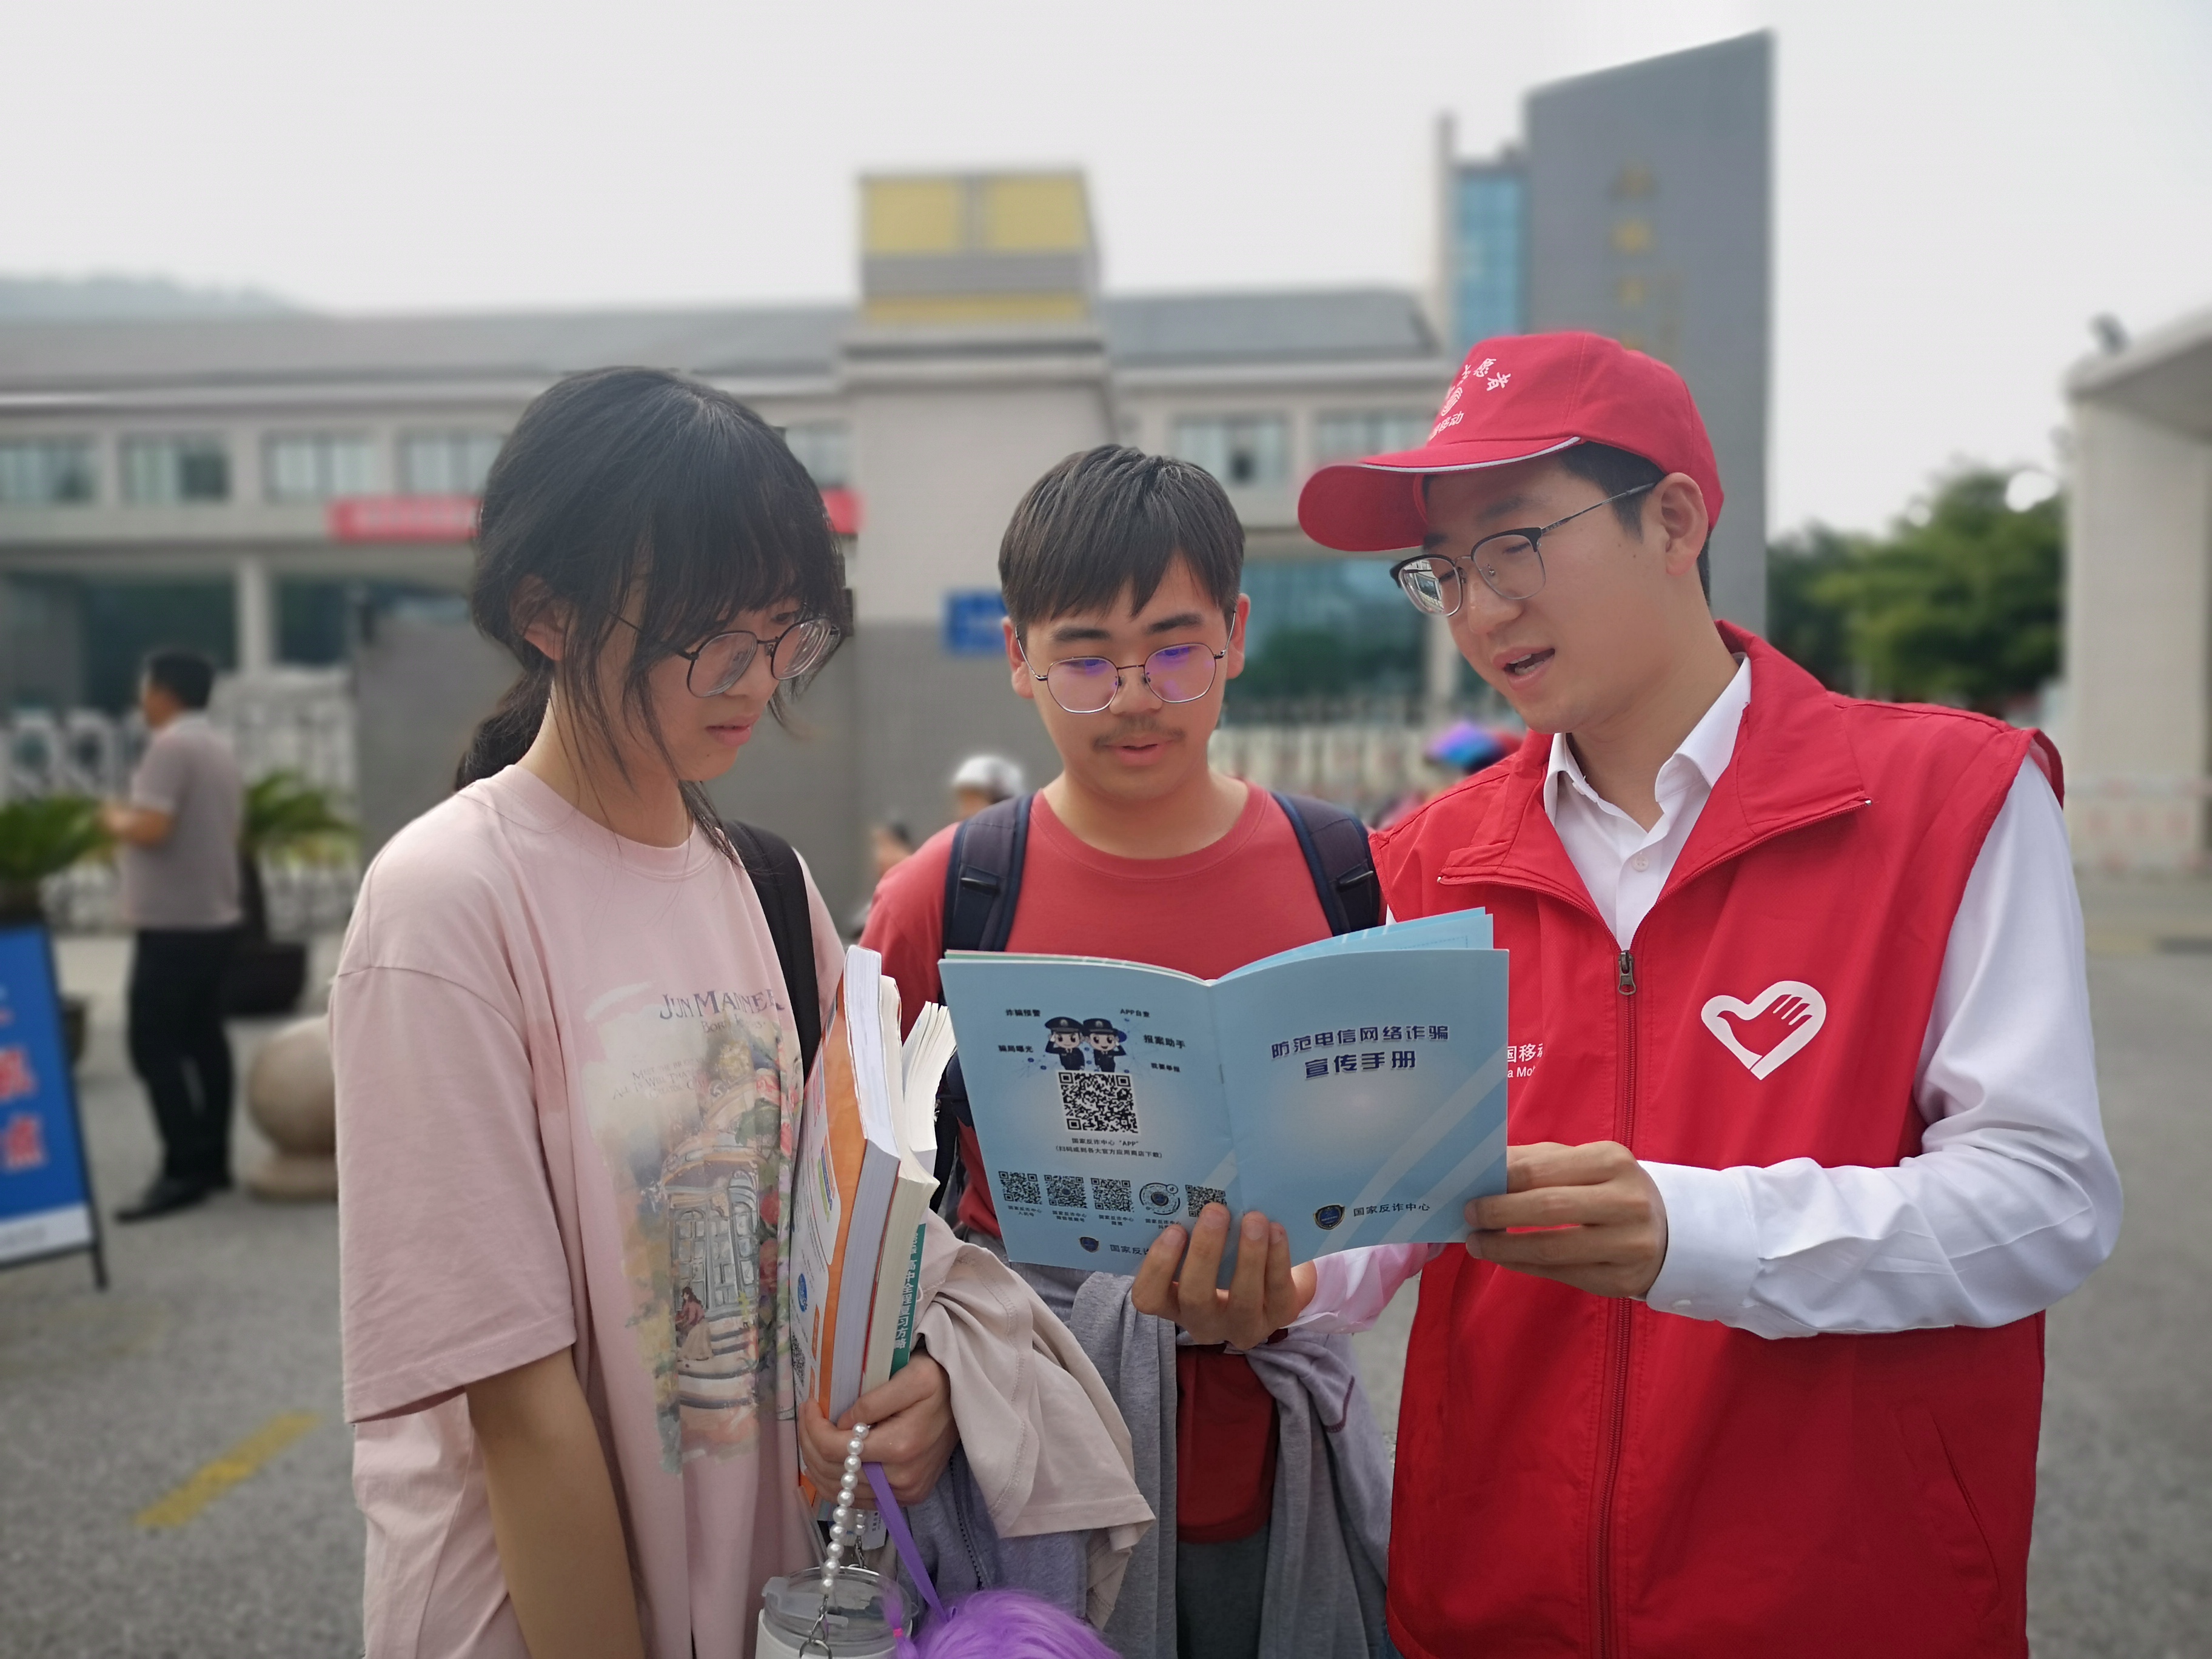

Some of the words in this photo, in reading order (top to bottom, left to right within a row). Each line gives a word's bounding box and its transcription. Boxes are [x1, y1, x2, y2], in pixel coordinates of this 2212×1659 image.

[1271, 1025, 1449, 1058] 防范电信网络诈骗
[1305, 1051, 1416, 1078] 宣传手册
[1353, 1203, 1430, 1217] 国家反诈中心
